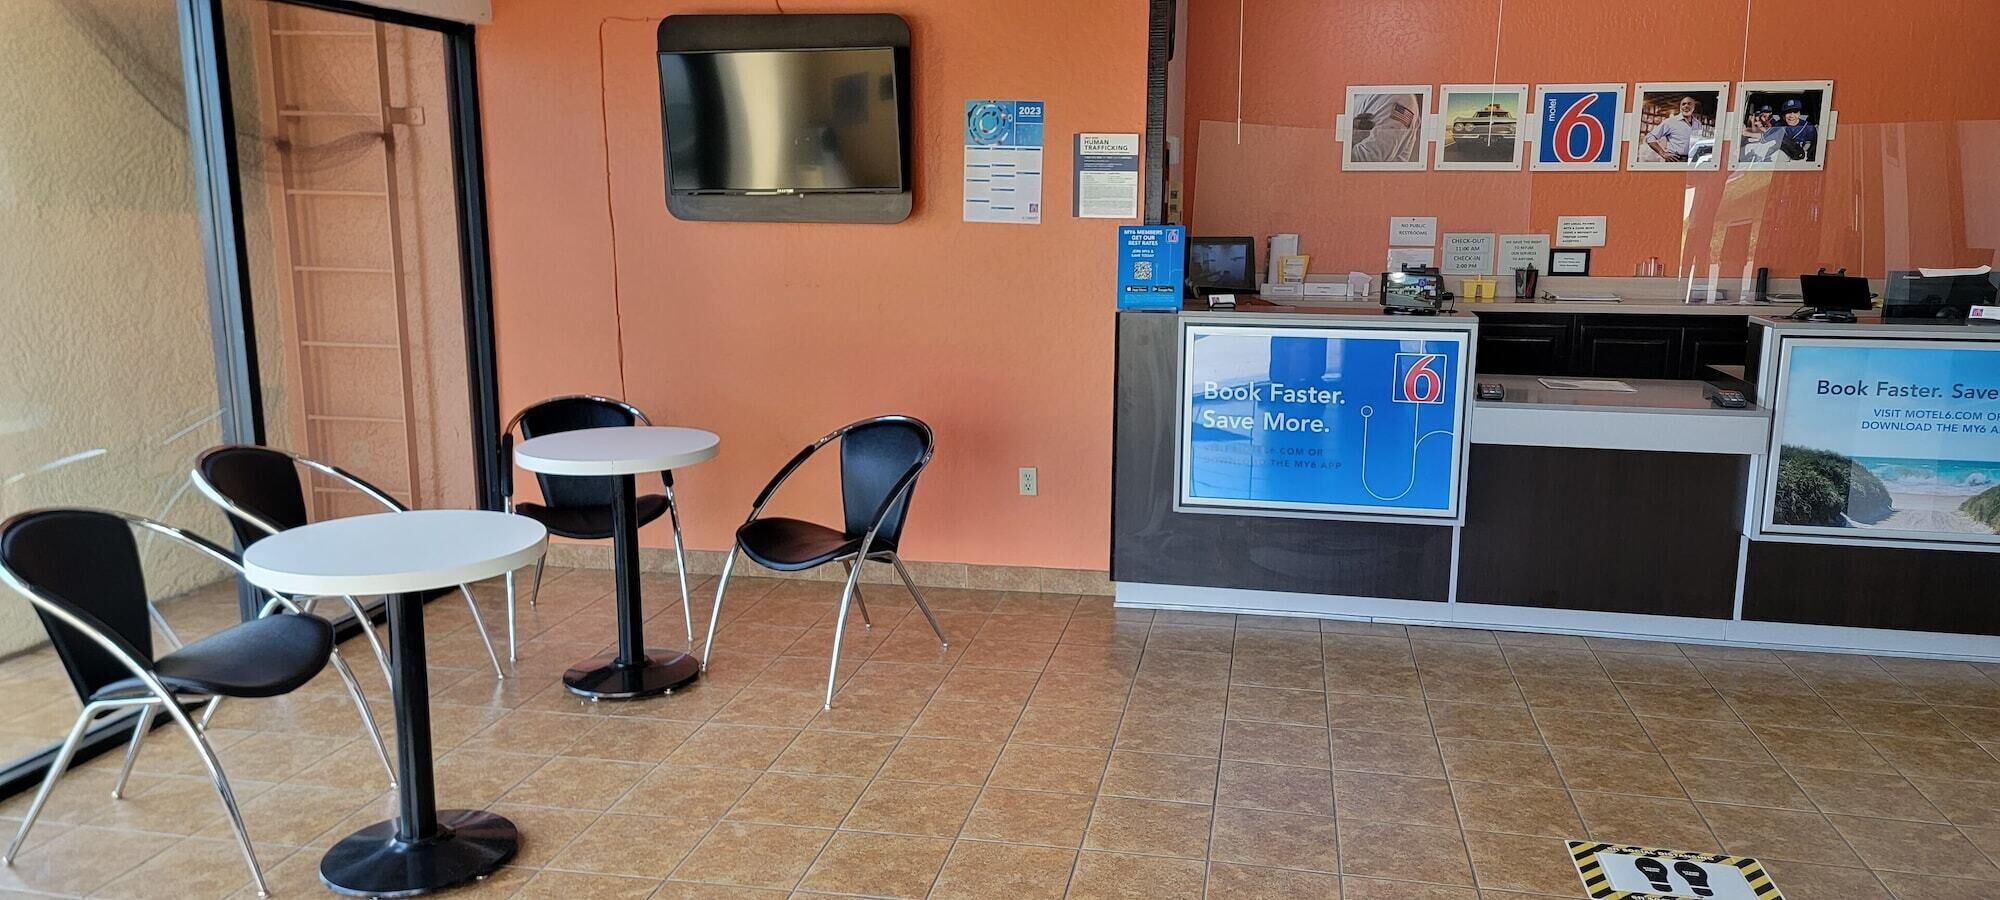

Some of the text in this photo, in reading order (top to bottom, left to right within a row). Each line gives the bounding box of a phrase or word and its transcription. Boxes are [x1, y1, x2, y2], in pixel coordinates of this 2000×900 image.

[1018, 106, 1042, 116] 2023
[1548, 98, 1558, 122] motel
[1552, 93, 1605, 163] 6
[1403, 354, 1442, 403] 6
[1816, 379, 2000, 400] Book Faster. Save
[1204, 381, 1346, 405] Book Faster.
[1202, 409, 1330, 433] Save More.
[1873, 408, 2000, 421] VISIT MOTEL6.COM O
[1861, 421, 1932, 432] DOWNLOAD
[1936, 423, 1959, 433] THE
[1962, 424, 1987, 434] MY6
[1271, 459, 1290, 468] THE
[1294, 460, 1317, 469] MY6
[1320, 461, 1343, 470] APP
